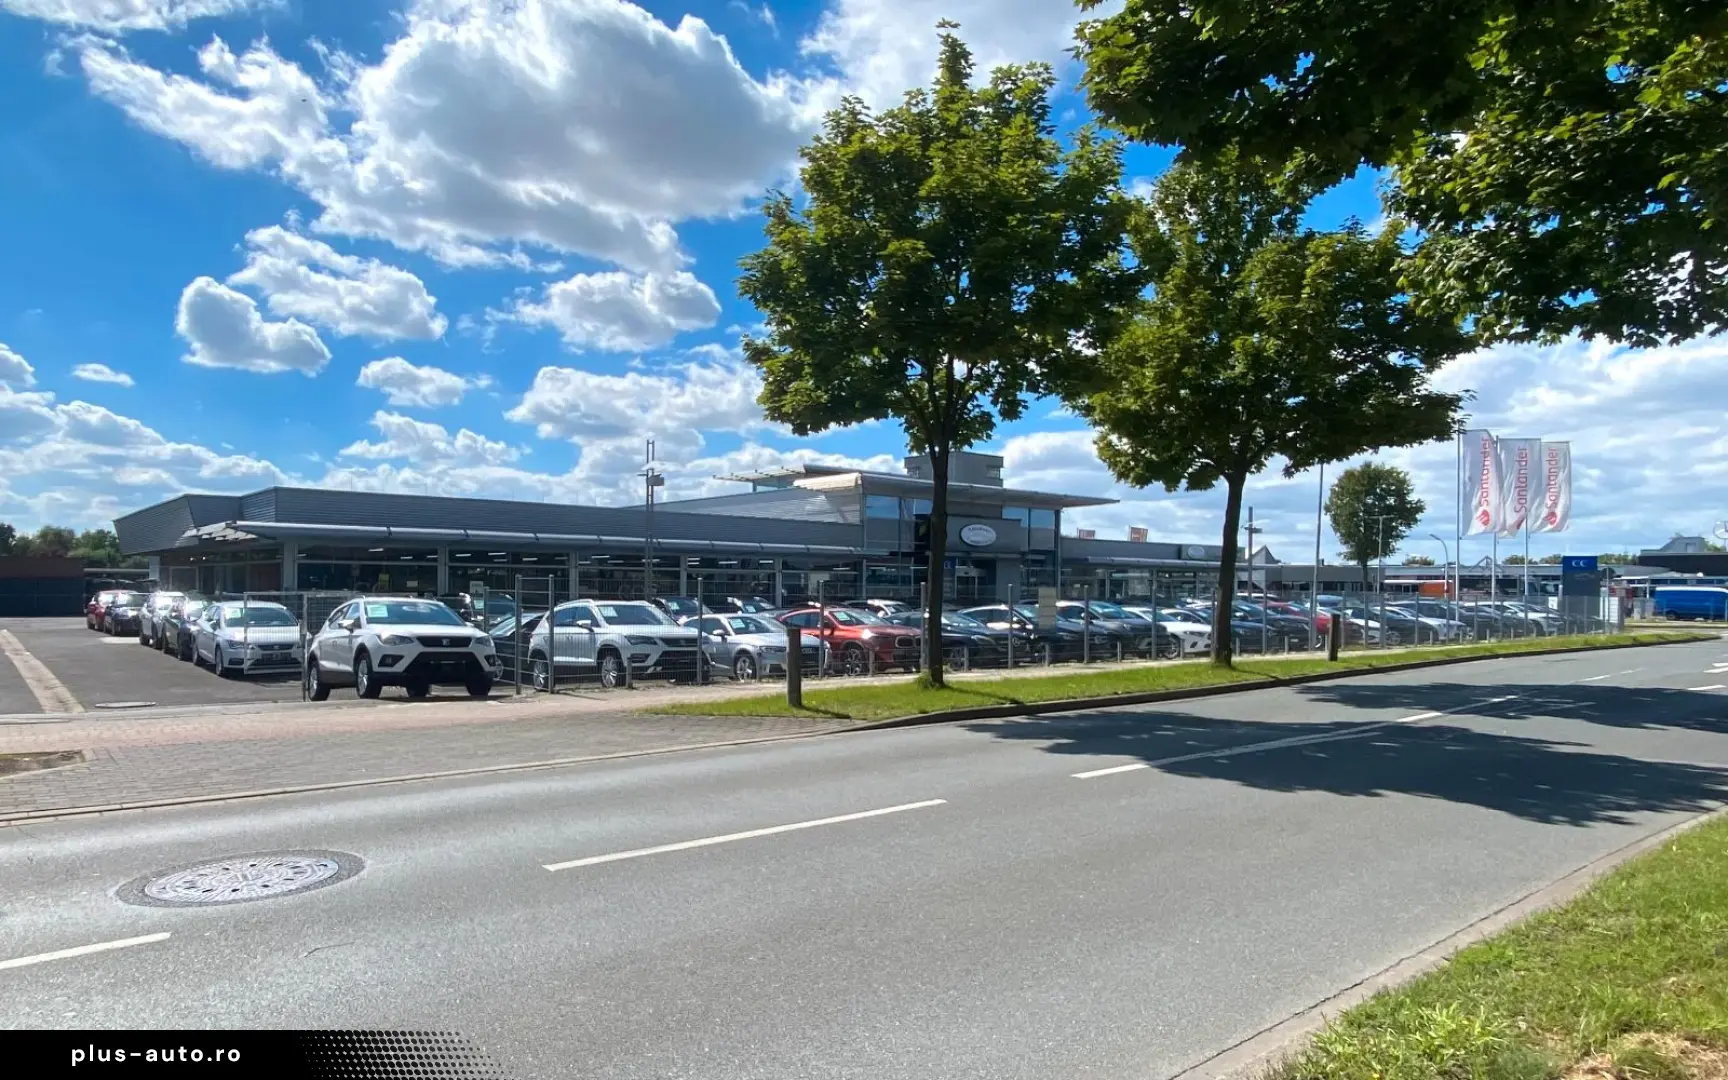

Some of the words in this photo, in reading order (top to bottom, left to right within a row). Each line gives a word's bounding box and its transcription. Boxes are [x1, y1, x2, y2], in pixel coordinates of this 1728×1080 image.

[1479, 437, 1490, 507] Santander
[1514, 447, 1528, 514] Santander
[1545, 448, 1559, 509] Santander
